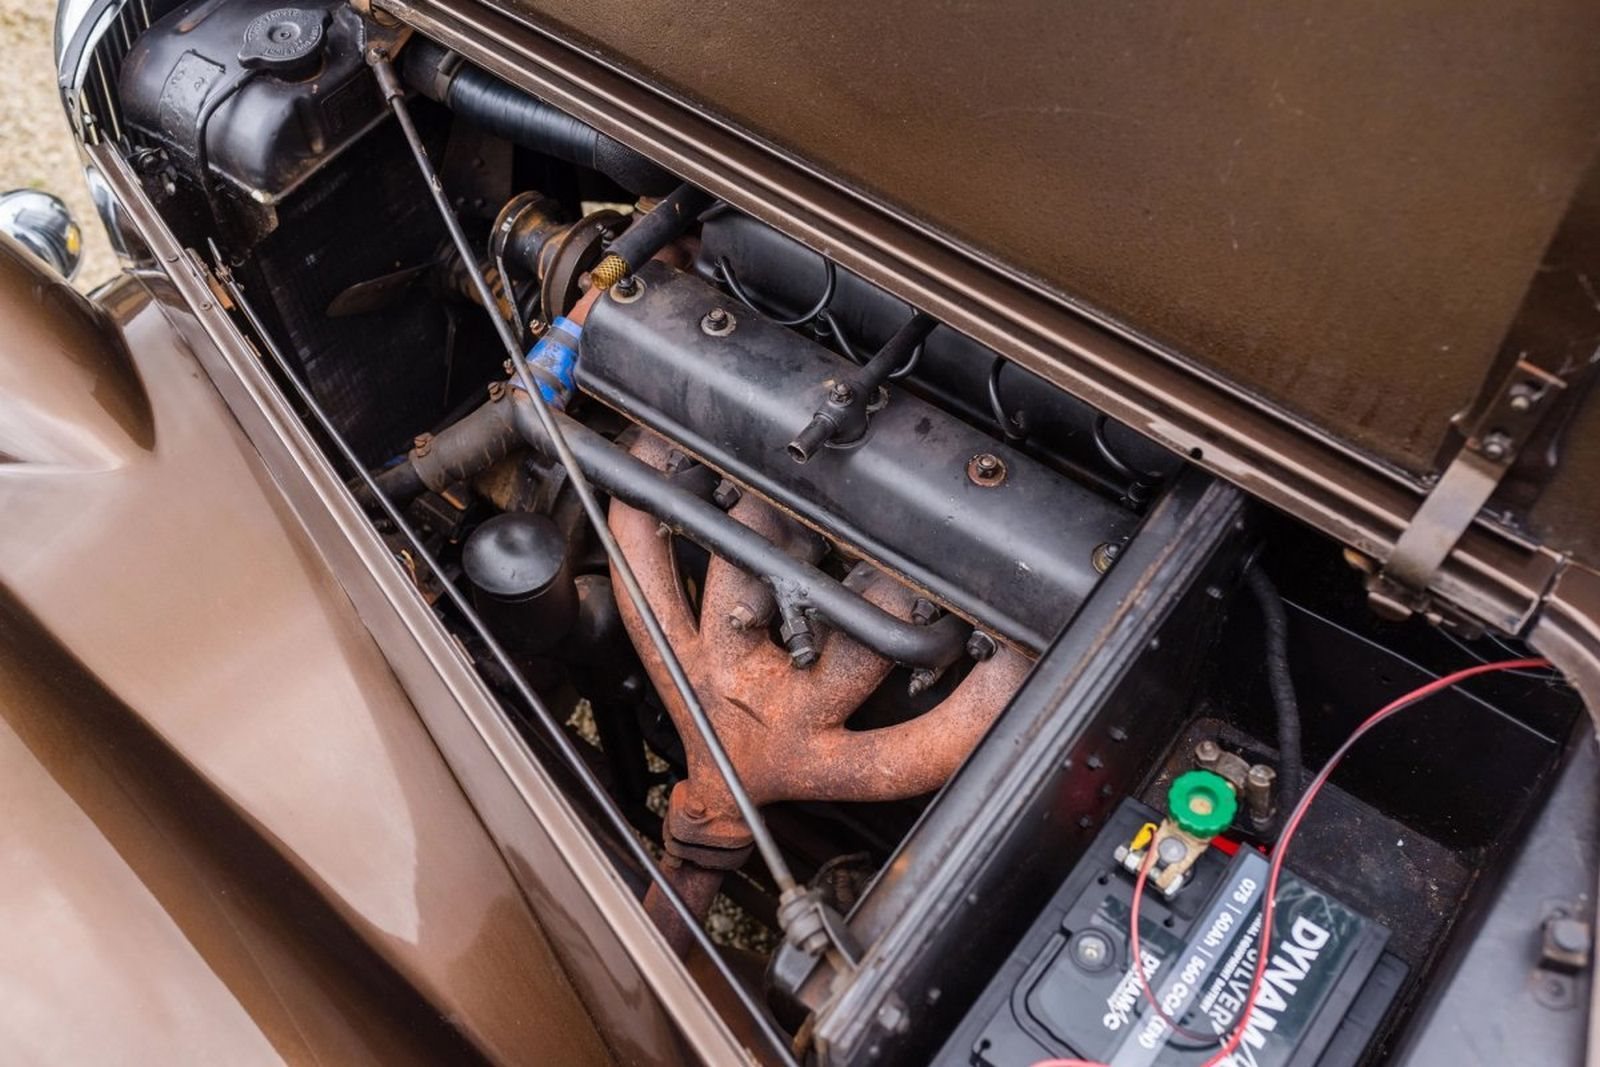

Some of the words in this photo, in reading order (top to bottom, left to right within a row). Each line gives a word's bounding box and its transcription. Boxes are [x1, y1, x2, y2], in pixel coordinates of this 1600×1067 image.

[1232, 877, 1257, 905] 075
[1203, 911, 1235, 948] 60Ah
[1180, 955, 1206, 983] 560
[1161, 982, 1189, 1016] CCA
[1199, 976, 1227, 1014] BATTERY
[1138, 1014, 1168, 1049] (EN)
